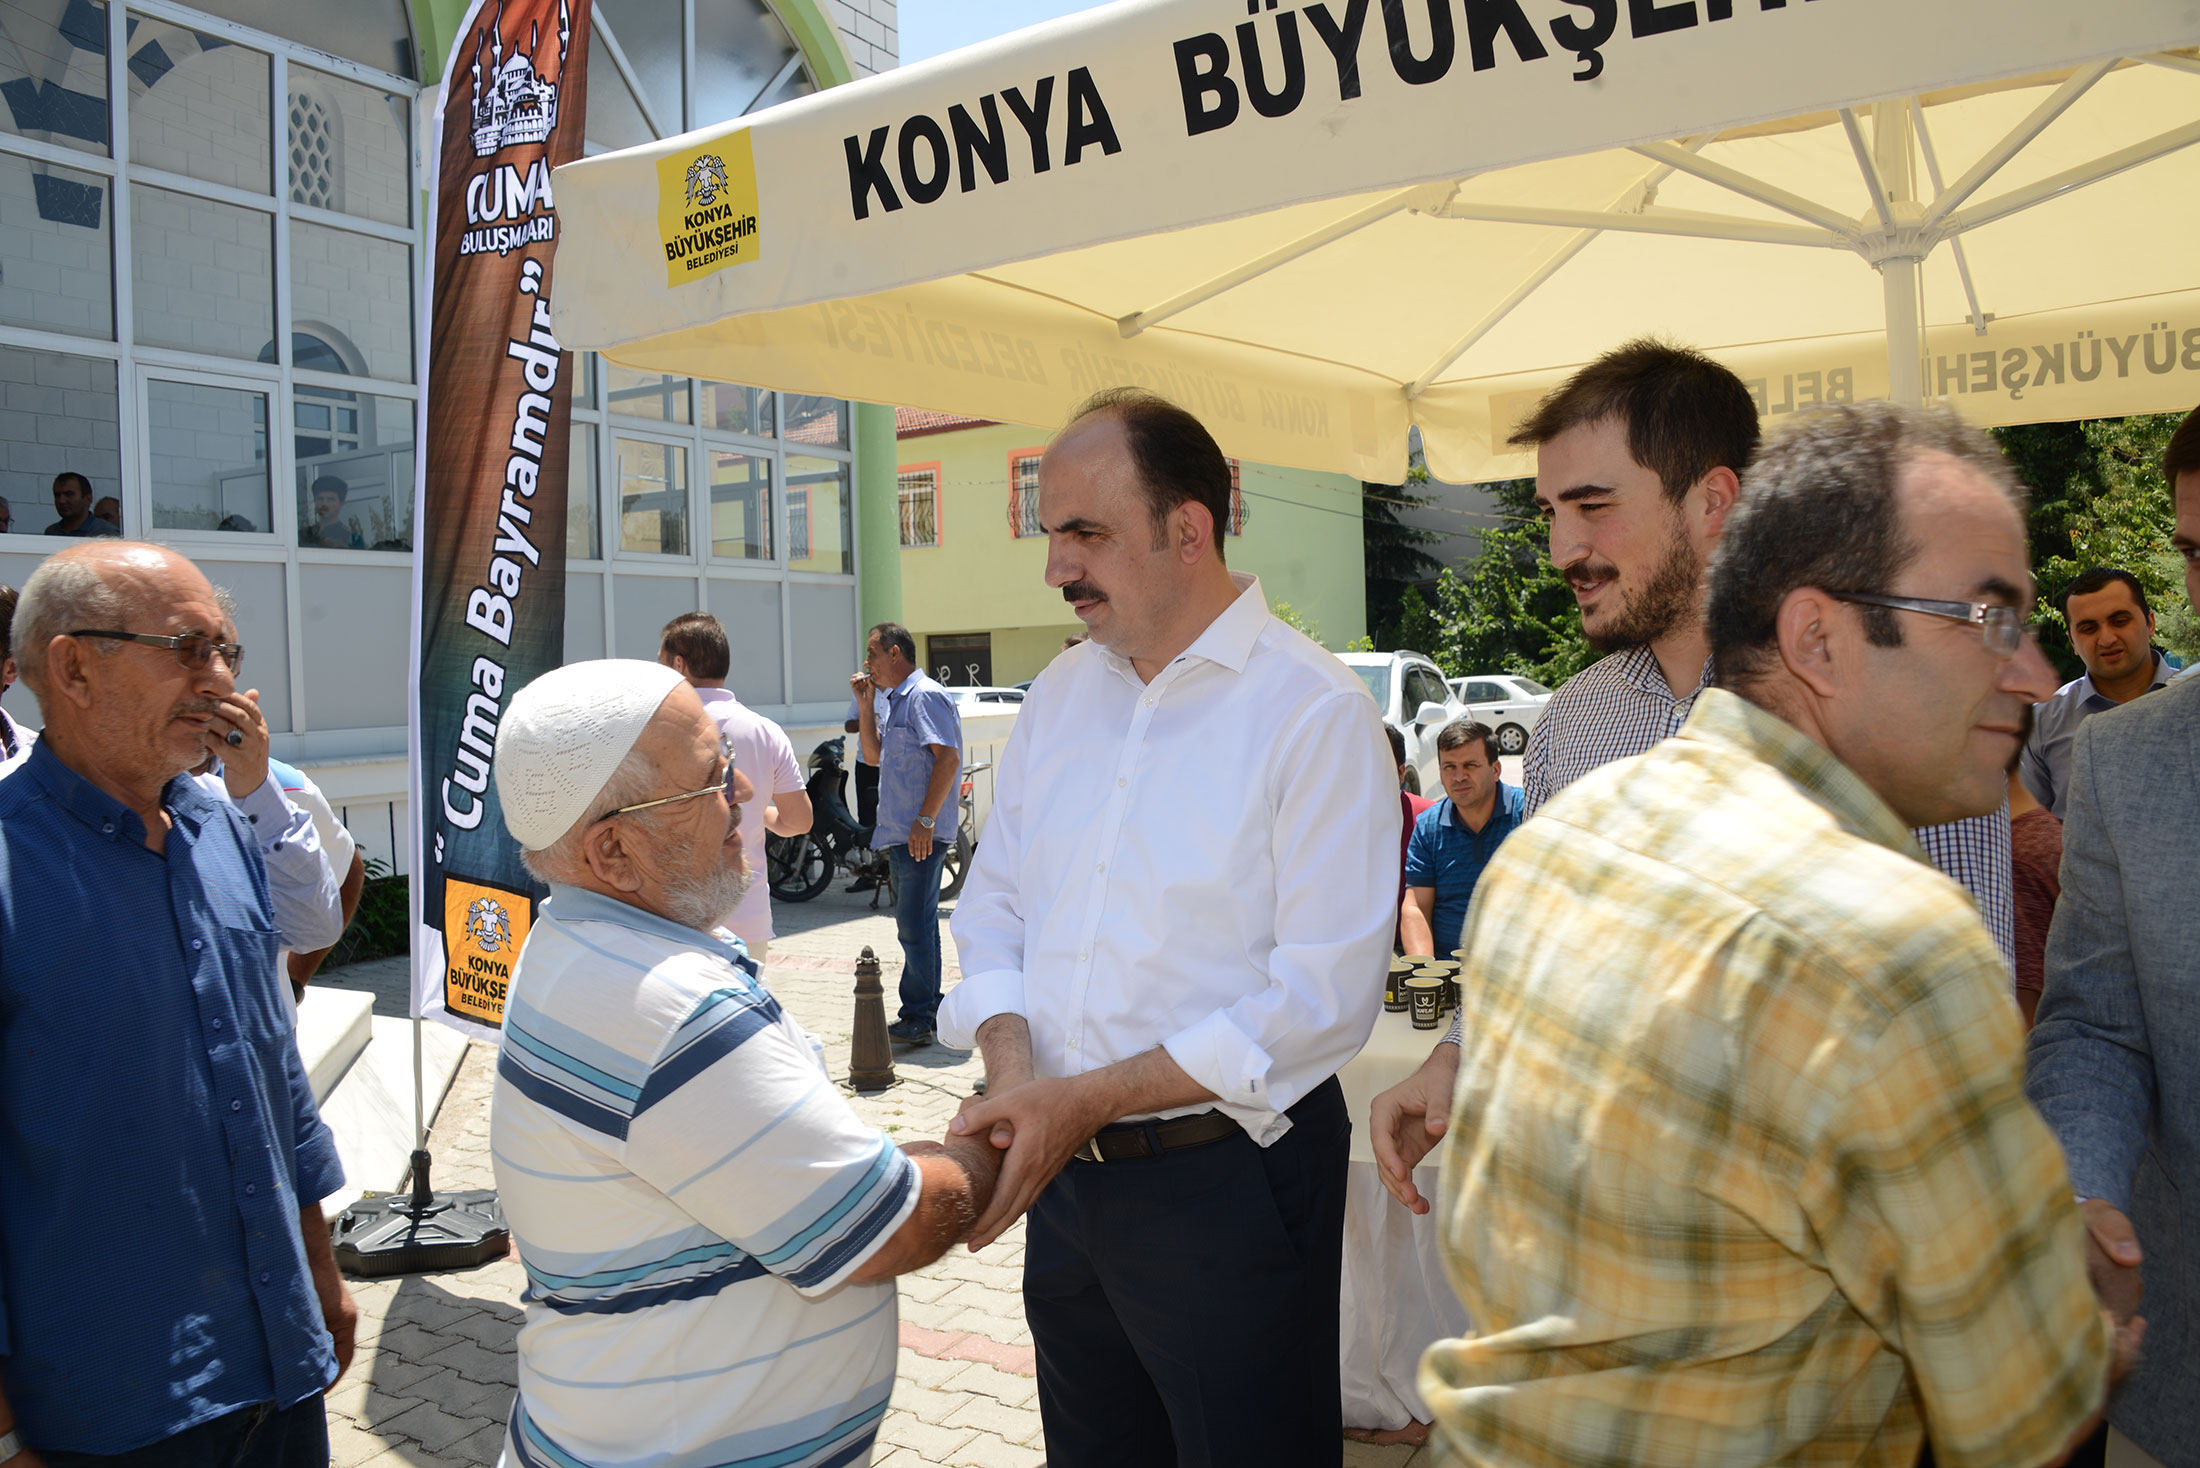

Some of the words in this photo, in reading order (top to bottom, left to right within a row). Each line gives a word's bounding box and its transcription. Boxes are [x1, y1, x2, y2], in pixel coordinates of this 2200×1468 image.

[844, 66, 1121, 221] KONYA
[1173, 0, 1820, 136] BÜYÜKŞ
[466, 155, 555, 225] CUMA
[684, 203, 732, 230] KONYA
[665, 214, 757, 261] BÜYÜKŞEHİR
[686, 241, 739, 271] BELEDİYESİ
[468, 955, 509, 979] KONYA
[450, 967, 507, 1001] BÜYÜKŞE
[461, 993, 504, 1014] BELEDİYE
